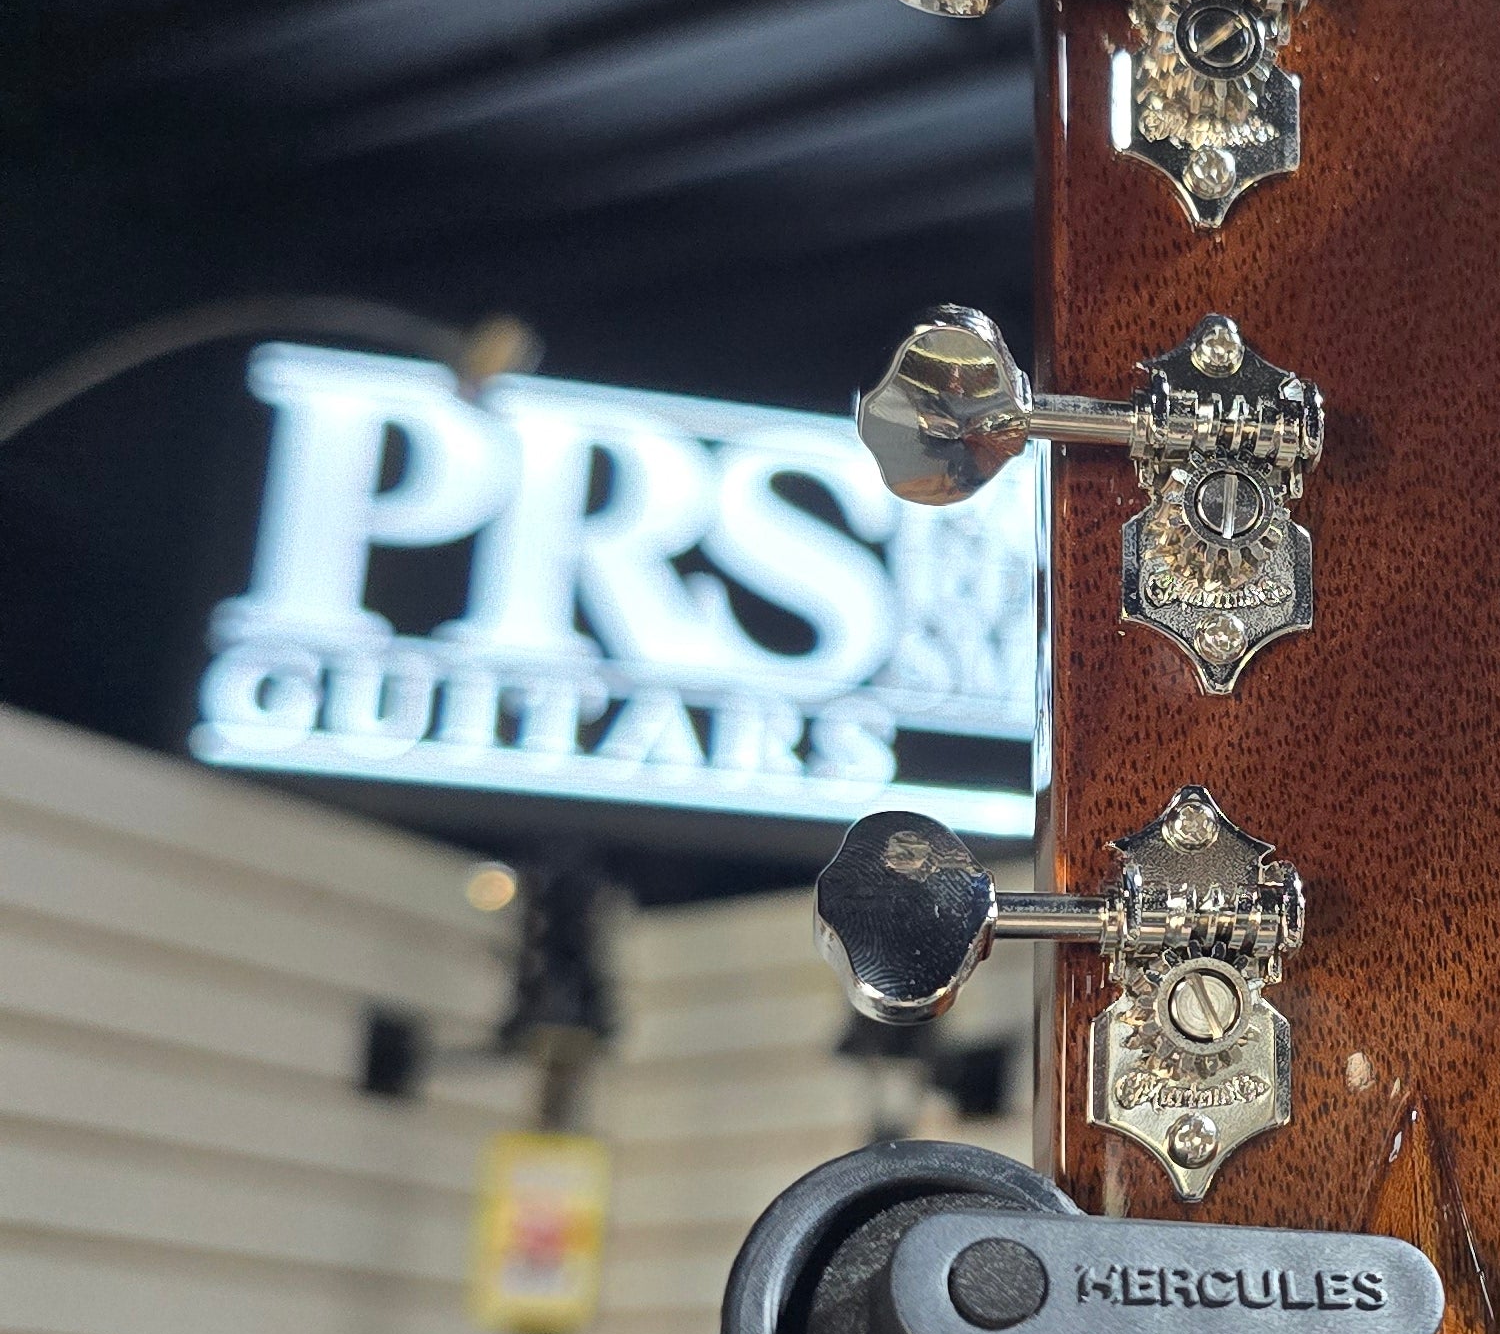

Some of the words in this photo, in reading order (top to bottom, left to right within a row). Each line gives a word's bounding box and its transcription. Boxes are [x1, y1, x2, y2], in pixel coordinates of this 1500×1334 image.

[210, 342, 898, 701] PRS
[197, 643, 898, 800] GUITARS
[1076, 1265, 1388, 1311] HERCULES
